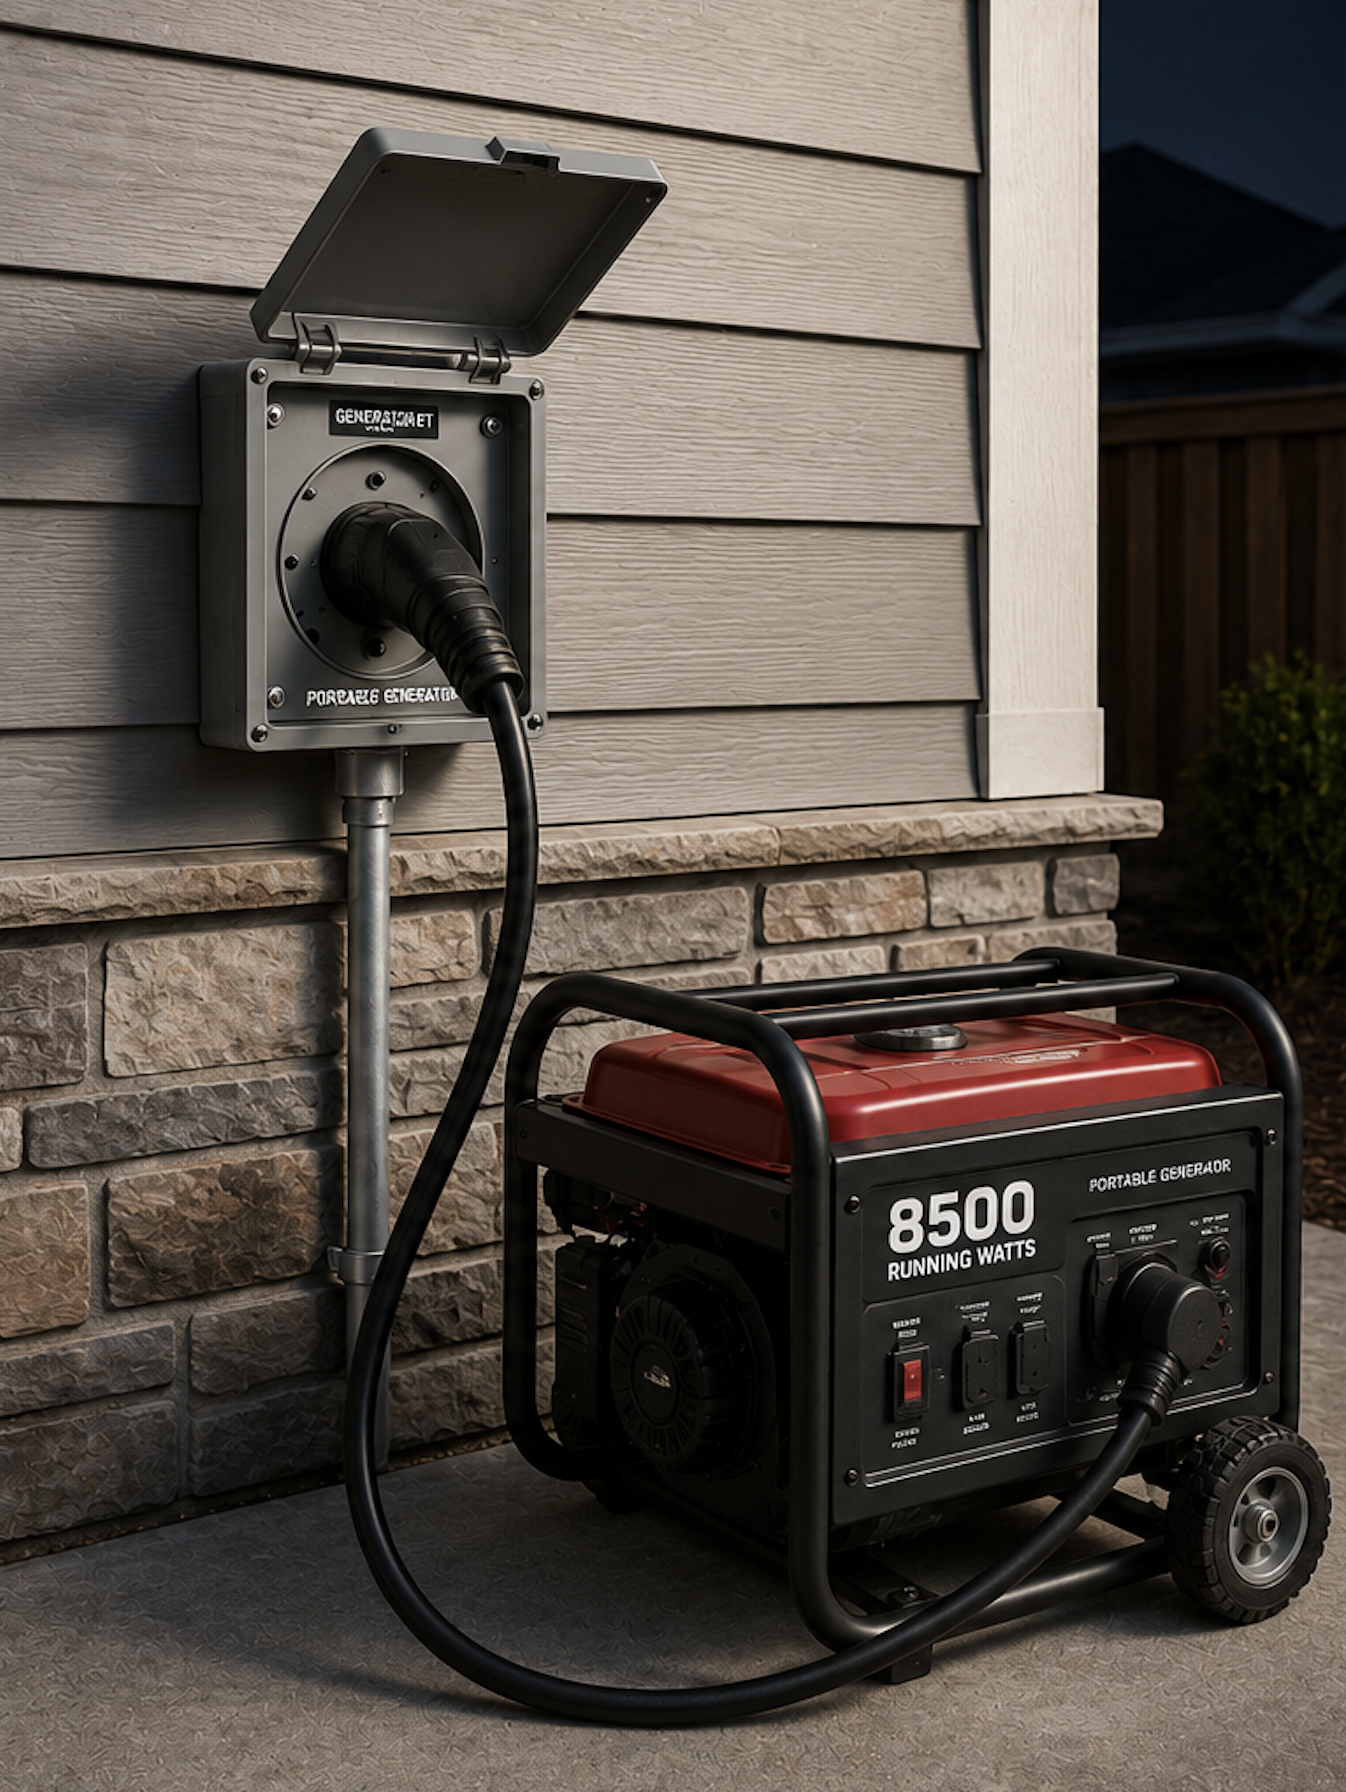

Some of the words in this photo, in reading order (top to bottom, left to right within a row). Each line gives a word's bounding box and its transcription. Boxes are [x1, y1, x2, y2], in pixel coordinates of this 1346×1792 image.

[1088, 1168, 1158, 1193] PORTABLE
[888, 1179, 1036, 1255] 8500
[887, 1249, 973, 1283] RUNNING
[975, 1237, 1037, 1267] WATTS
